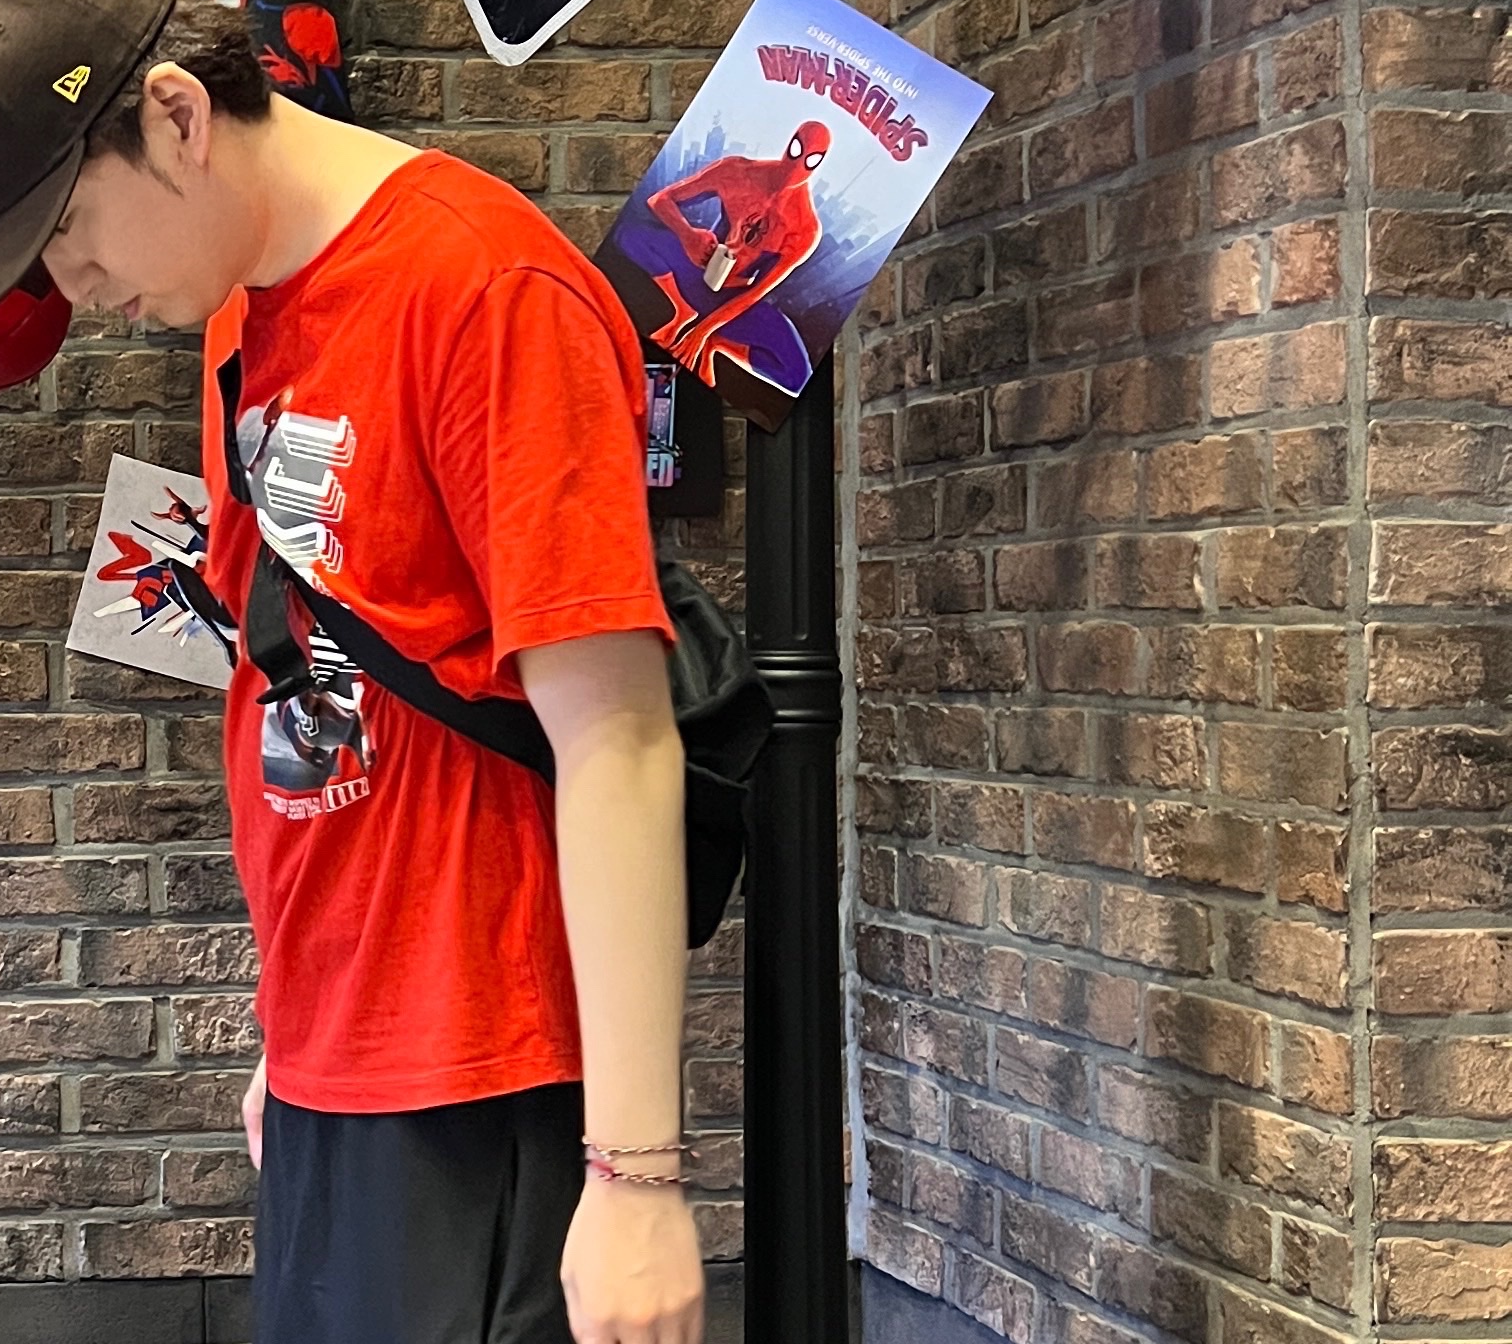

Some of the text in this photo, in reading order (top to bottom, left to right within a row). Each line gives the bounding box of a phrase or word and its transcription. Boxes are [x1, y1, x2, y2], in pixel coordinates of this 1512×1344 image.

[871, 63, 893, 84] THE
[892, 76, 920, 99] INTO
[757, 44, 929, 161] SPIDER-MAN
